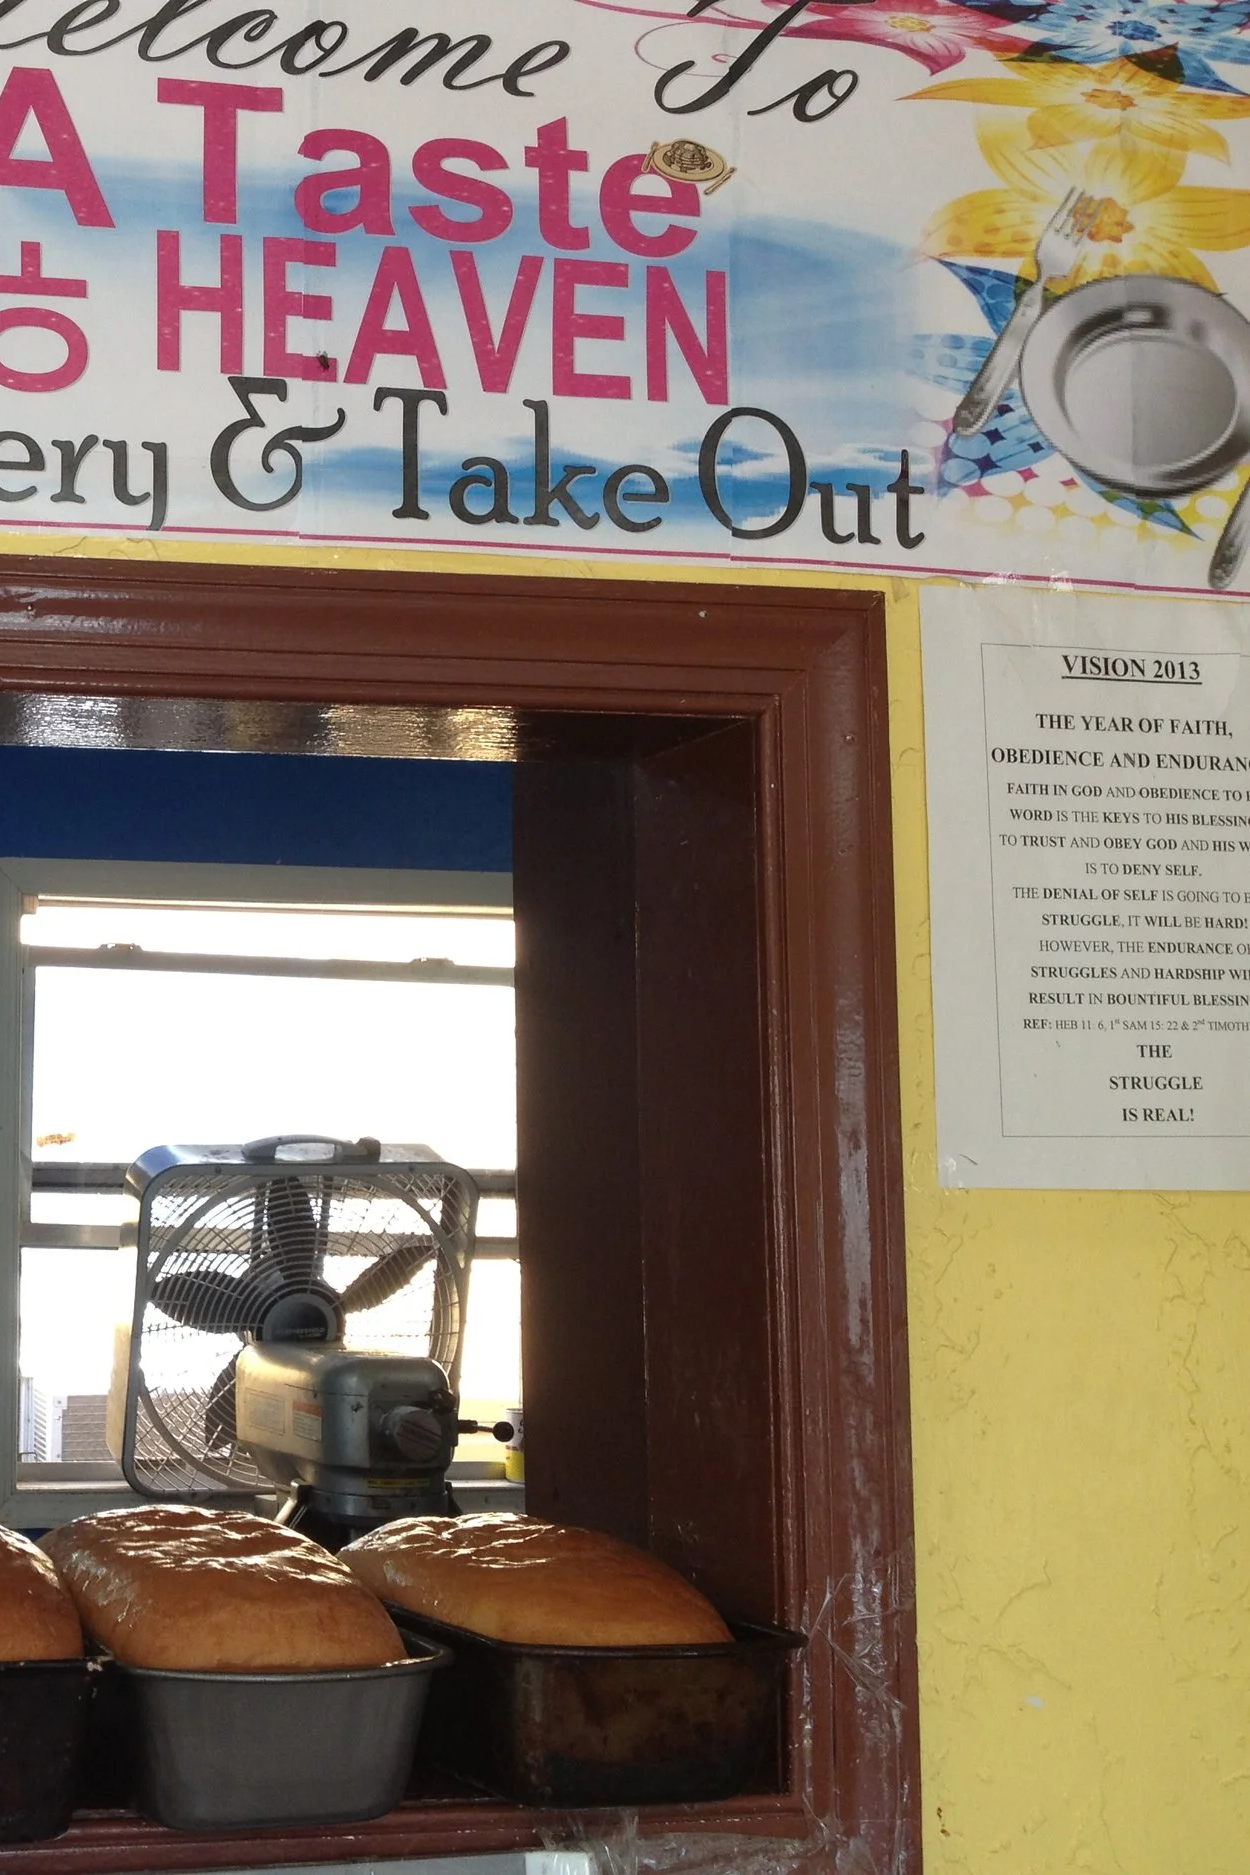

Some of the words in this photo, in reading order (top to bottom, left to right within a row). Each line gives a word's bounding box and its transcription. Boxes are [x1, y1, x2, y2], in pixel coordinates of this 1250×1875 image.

[157, 78, 701, 258] Taste
[157, 231, 729, 405] HEAVEN
[210, 375, 346, 512] &
[373, 386, 670, 533] Take
[698, 406, 926, 550] Out
[1061, 654, 1146, 678] VISION
[1153, 659, 1201, 681] 2013
[1035, 713, 1076, 730] THE
[1080, 715, 1135, 733] YEAR
[1138, 717, 1165, 734] OF
[1169, 718, 1233, 737] FAITH,
[991, 747, 1105, 767] OBEDIENCE
[1109, 752, 1151, 769] AND
[1156, 753, 1250, 772] ENDURAN
[1006, 782, 1049, 796] FAITH
[1053, 784, 1068, 796] IN
[1071, 784, 1103, 798] GOD
[1105, 786, 1137, 799] AND
[1138, 786, 1221, 801] OBEDIENCE
[1222, 789, 1243, 802] TO
[1009, 808, 1053, 822] WORD
[1055, 809, 1069, 823] IS
[1070, 810, 1100, 824] THE
[1102, 811, 1141, 825] KEYS
[1142, 812, 1163, 825] TO
[1165, 812, 1189, 826] HIS
[1191, 813, 1250, 828] BLESSIN
[998, 833, 1018, 847] TO
[1019, 834, 1067, 848] TRUST
[1069, 836, 1101, 849] AND
[1103, 836, 1143, 850] OBEY
[1145, 837, 1178, 851] GOD
[1180, 839, 1210, 852] AND
[1211, 840, 1236, 853] HIS
[1085, 862, 1098, 875] IS
[1100, 862, 1120, 875] TO
[1121, 863, 1162, 876] DENY
[1165, 864, 1202, 877] SELF.
[1012, 886, 1040, 900] THE
[1042, 887, 1099, 901] DENIAL
[1100, 888, 1121, 901] OF
[1123, 889, 1159, 902] SELF
[1161, 889, 1175, 902] IS
[1176, 889, 1220, 904] GOING
[1221, 891, 1241, 904] TO
[1041, 913, 1125, 928] STRUGGLE,
[1127, 914, 1142, 927] IT
[1143, 915, 1182, 928] WILL
[1183, 915, 1203, 929] BE
[1204, 916, 1249, 930] HARD!
[1039, 939, 1115, 955] HOWEVER,
[1116, 940, 1145, 954] THE
[1147, 941, 1234, 955] ENDURANCE
[1030, 965, 1118, 979] STRUGGLES
[1119, 967, 1151, 980] AND
[1153, 967, 1226, 981] HARDSHIP
[1028, 992, 1085, 1005] RESULT
[1088, 992, 1103, 1005] IN
[1106, 993, 1191, 1006] BOUNTIFUL
[1023, 1018, 1052, 1030] REF:
[1055, 1019, 1079, 1030] HEB
[1122, 1019, 1148, 1031] SAM
[1166, 1020, 1179, 1031] 22
[1180, 1020, 1190, 1031] &
[1136, 1044, 1173, 1059] THE
[1109, 1075, 1204, 1091] STRUGGLE
[1122, 1107, 1139, 1122] IS
[1142, 1107, 1195, 1122] REAL!
